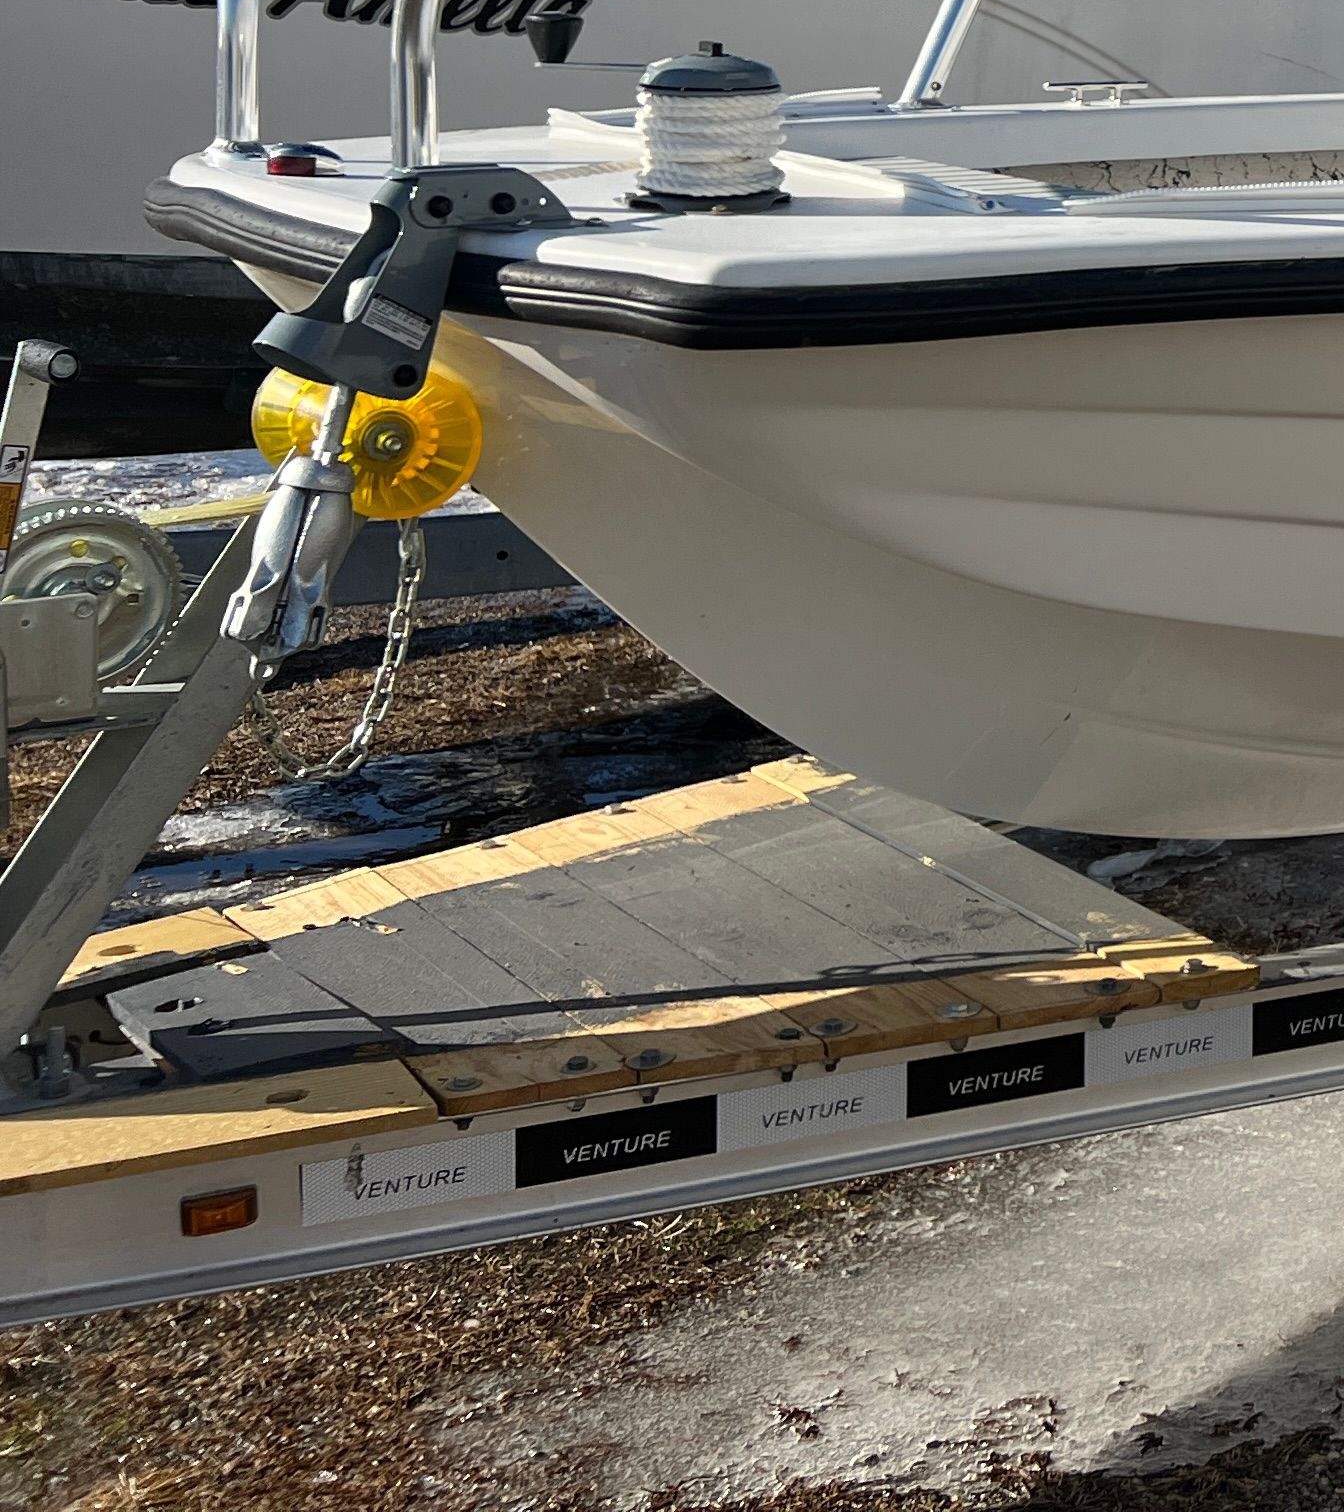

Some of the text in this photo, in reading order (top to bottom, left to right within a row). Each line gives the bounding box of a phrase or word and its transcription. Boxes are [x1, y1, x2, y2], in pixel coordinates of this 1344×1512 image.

[1123, 1036, 1214, 1065] VENTURE
[948, 1065, 1044, 1095] VENTURE
[762, 1097, 863, 1129] VENTURE
[563, 1130, 672, 1164] VENTURE
[354, 1166, 468, 1200] VENTURE
